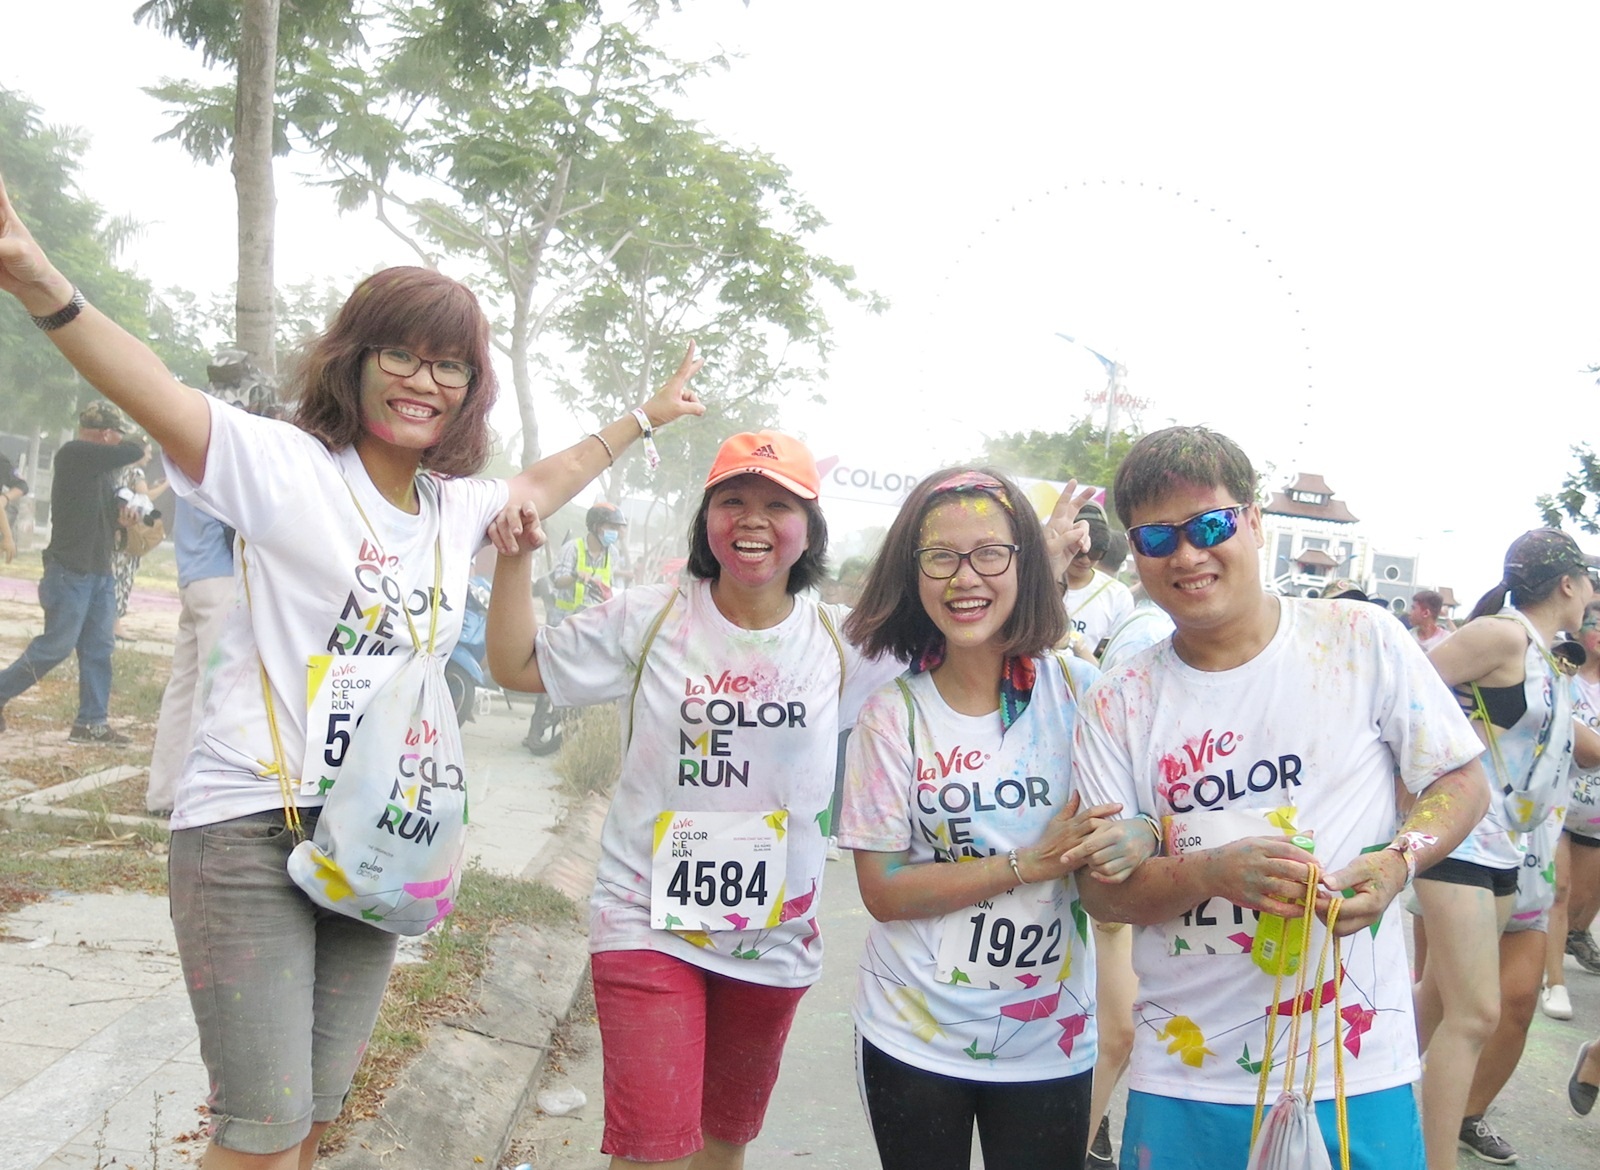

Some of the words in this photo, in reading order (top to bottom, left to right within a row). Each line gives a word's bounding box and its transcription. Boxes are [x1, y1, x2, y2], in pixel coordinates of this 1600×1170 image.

[751, 452, 779, 461] adidas
[355, 564, 453, 616] COOR
[340, 590, 399, 639] ME
[331, 690, 349, 700] ME
[332, 679, 371, 689] COLOR
[331, 700, 354, 710] RUN
[680, 697, 807, 729] COLOR
[680, 729, 733, 757] ME
[678, 758, 750, 788] RUN
[1167, 754, 1302, 813] COLOR
[390, 776, 432, 816] ME
[917, 776, 1052, 815] COLOR
[1573, 791, 1595, 806] RUN
[376, 803, 440, 847] RUN
[672, 831, 708, 840] COLOR
[918, 817, 974, 844] ME
[672, 840, 688, 849] ME
[672, 849, 692, 858] RUN
[1174, 836, 1202, 848] COLOR
[667, 860, 768, 907] 4584
[968, 912, 1062, 968] 1922
